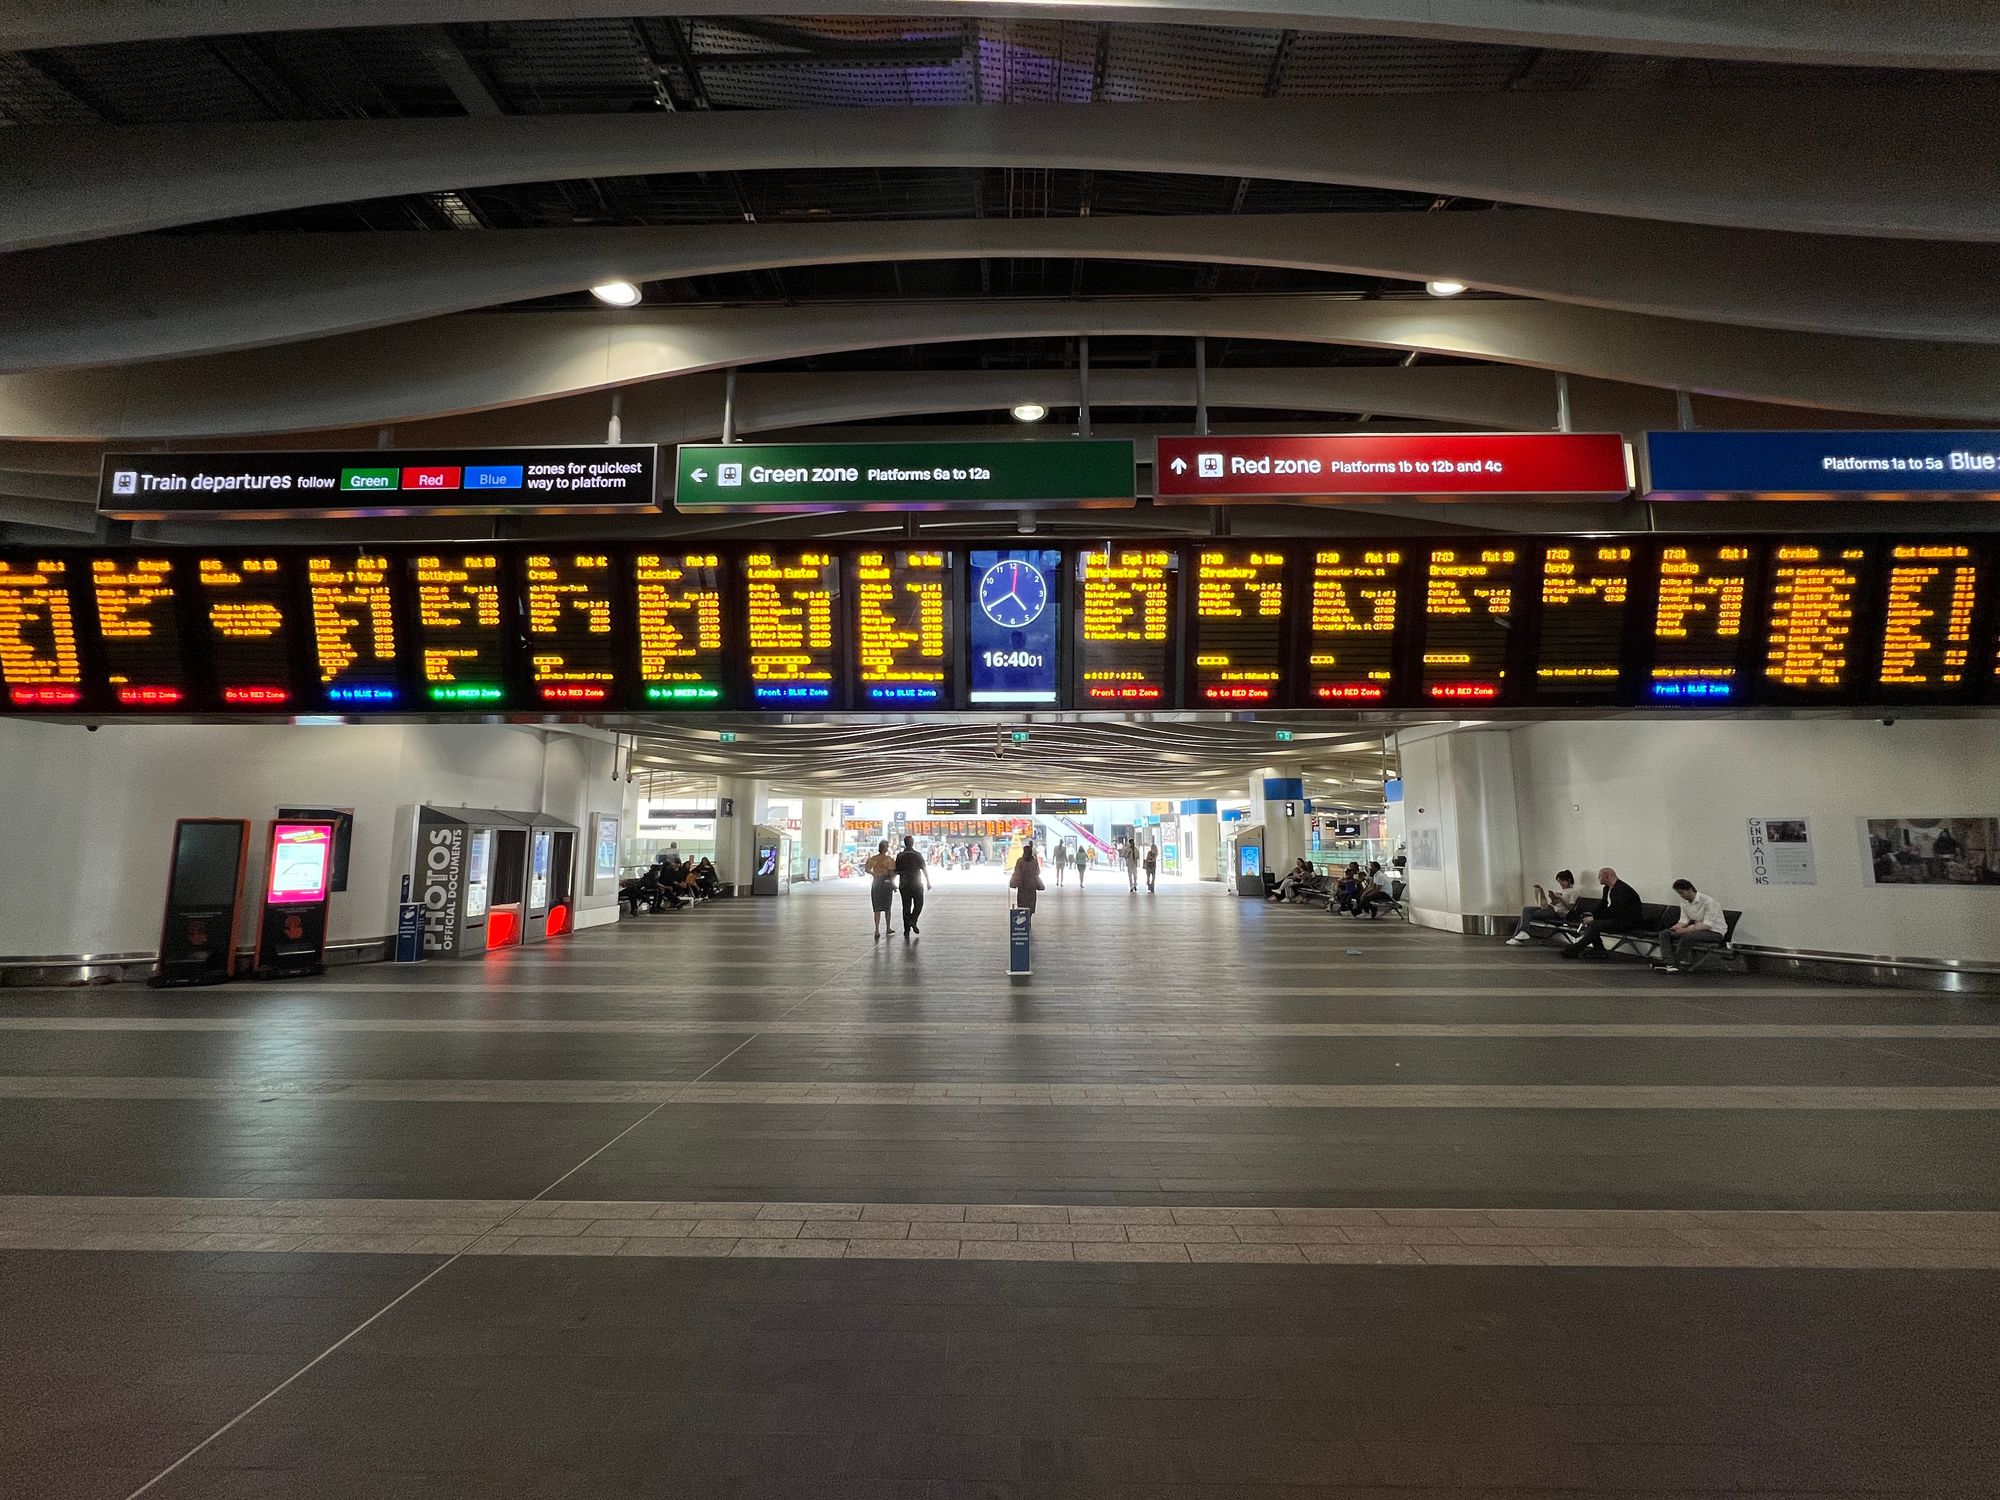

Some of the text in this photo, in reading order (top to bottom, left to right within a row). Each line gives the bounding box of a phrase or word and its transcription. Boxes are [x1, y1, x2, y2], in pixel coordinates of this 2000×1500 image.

[1231, 456, 1503, 475] Red zone Platforms 1b to 12b and 4c
[1823, 457, 1890, 471] Platforms
[1891, 457, 1906, 471] 1a
[1907, 457, 1923, 471] to
[1925, 457, 1944, 471] 5a
[1949, 451, 1996, 471] Blue
[528, 461, 643, 476] zones for quickest
[749, 466, 991, 483] Green zone Platforms 6a to 12a
[140, 472, 508, 493] Train departures follow Green Red Blue
[528, 476, 626, 491] way to platform
[1316, 552, 1340, 564] 17:00
[1364, 552, 1384, 564] Plat
[1431, 551, 1515, 563] 17:03 Plat 9B
[1546, 548, 1617, 560] 17:03 Plat
[1720, 548, 1740, 560] Plat
[1778, 548, 1819, 559] Arrivals
[1956, 546, 1969, 558] to
[576, 556, 595, 568] Plat
[801, 554, 820, 566] Plat
[821, 554, 831, 566] 4
[907, 554, 921, 566] On
[1121, 553, 1143, 566] Expt
[1249, 553, 1263, 565] On
[1264, 553, 1284, 565] time
[637, 568, 683, 581] Leicester
[748, 568, 819, 579] London Euston
[858, 567, 891, 580] Walsall
[1084, 567, 1164, 579] Manchester Picc
[1199, 567, 1258, 580] Shrewsbury
[1375, 568, 1386, 577] St
[1429, 564, 1488, 576] Bromsgrove
[1544, 562, 1575, 575] Derby
[1660, 563, 1700, 574] Reading
[200, 573, 241, 584] Redditch
[356, 572, 383, 583] Valley
[417, 571, 468, 582] Nottingham
[528, 570, 559, 581] Crewe
[1024, 614, 1030, 622] 5
[983, 651, 1043, 668] 16:40 01
[225, 691, 237, 699] Go
[239, 691, 249, 699] to
[266, 691, 286, 699] Zone
[330, 689, 393, 698] Go to BLUE Zone
[446, 689, 456, 698] to
[481, 689, 501, 698] Zone
[544, 688, 604, 697] Go to RED Zone
[662, 688, 673, 698] to
[698, 688, 719, 698] Zone
[758, 688, 782, 697] Front
[788, 688, 808, 697] BLUE
[809, 688, 829, 697] Zone
[872, 688, 937, 697] Go to BLUE Zone
[1091, 688, 1116, 697] Front
[1122, 688, 1137, 697] RED
[1138, 688, 1159, 697] Zone
[1207, 688, 1269, 697] Go to RED Zone
[1319, 688, 1381, 697] Go to RED Zone
[1431, 687, 1494, 696] Go to RED Zone
[1655, 685, 1680, 694] Front
[1687, 685, 1707, 694] BLUE
[1708, 685, 1730, 694] Zone
[447, 828, 463, 899] DOCUMENTS
[423, 828, 453, 951] PHOTOS
[443, 901, 457, 951] OFFICIAL
